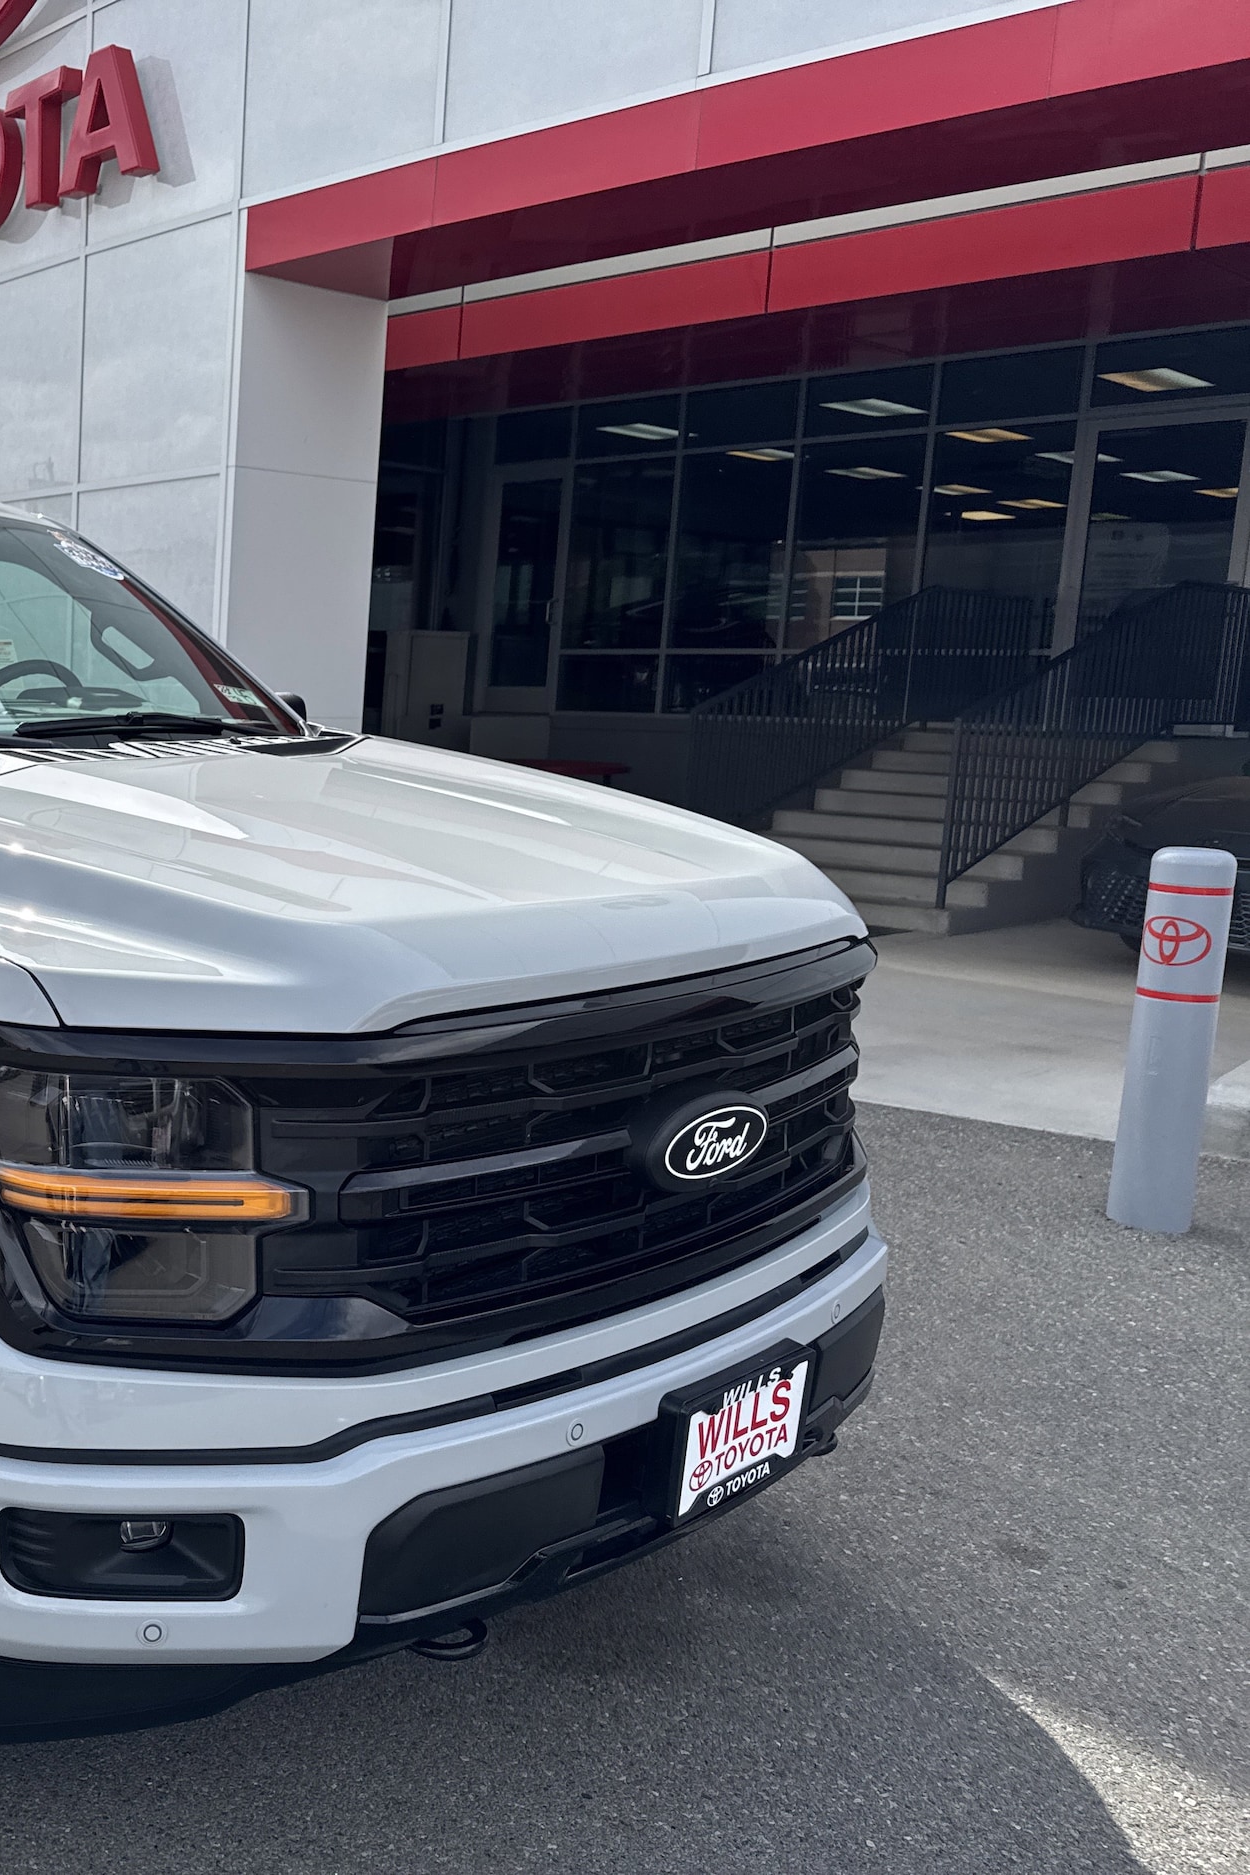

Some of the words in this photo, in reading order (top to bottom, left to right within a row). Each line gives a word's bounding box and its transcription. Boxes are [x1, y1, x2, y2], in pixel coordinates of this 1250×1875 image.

[686, 1117, 750, 1171] Ford
[722, 1366, 782, 1408] WILLS
[698, 1380, 791, 1460] WILLS
[715, 1423, 788, 1476] TOYOTA
[725, 1462, 771, 1496] TOYOTA
